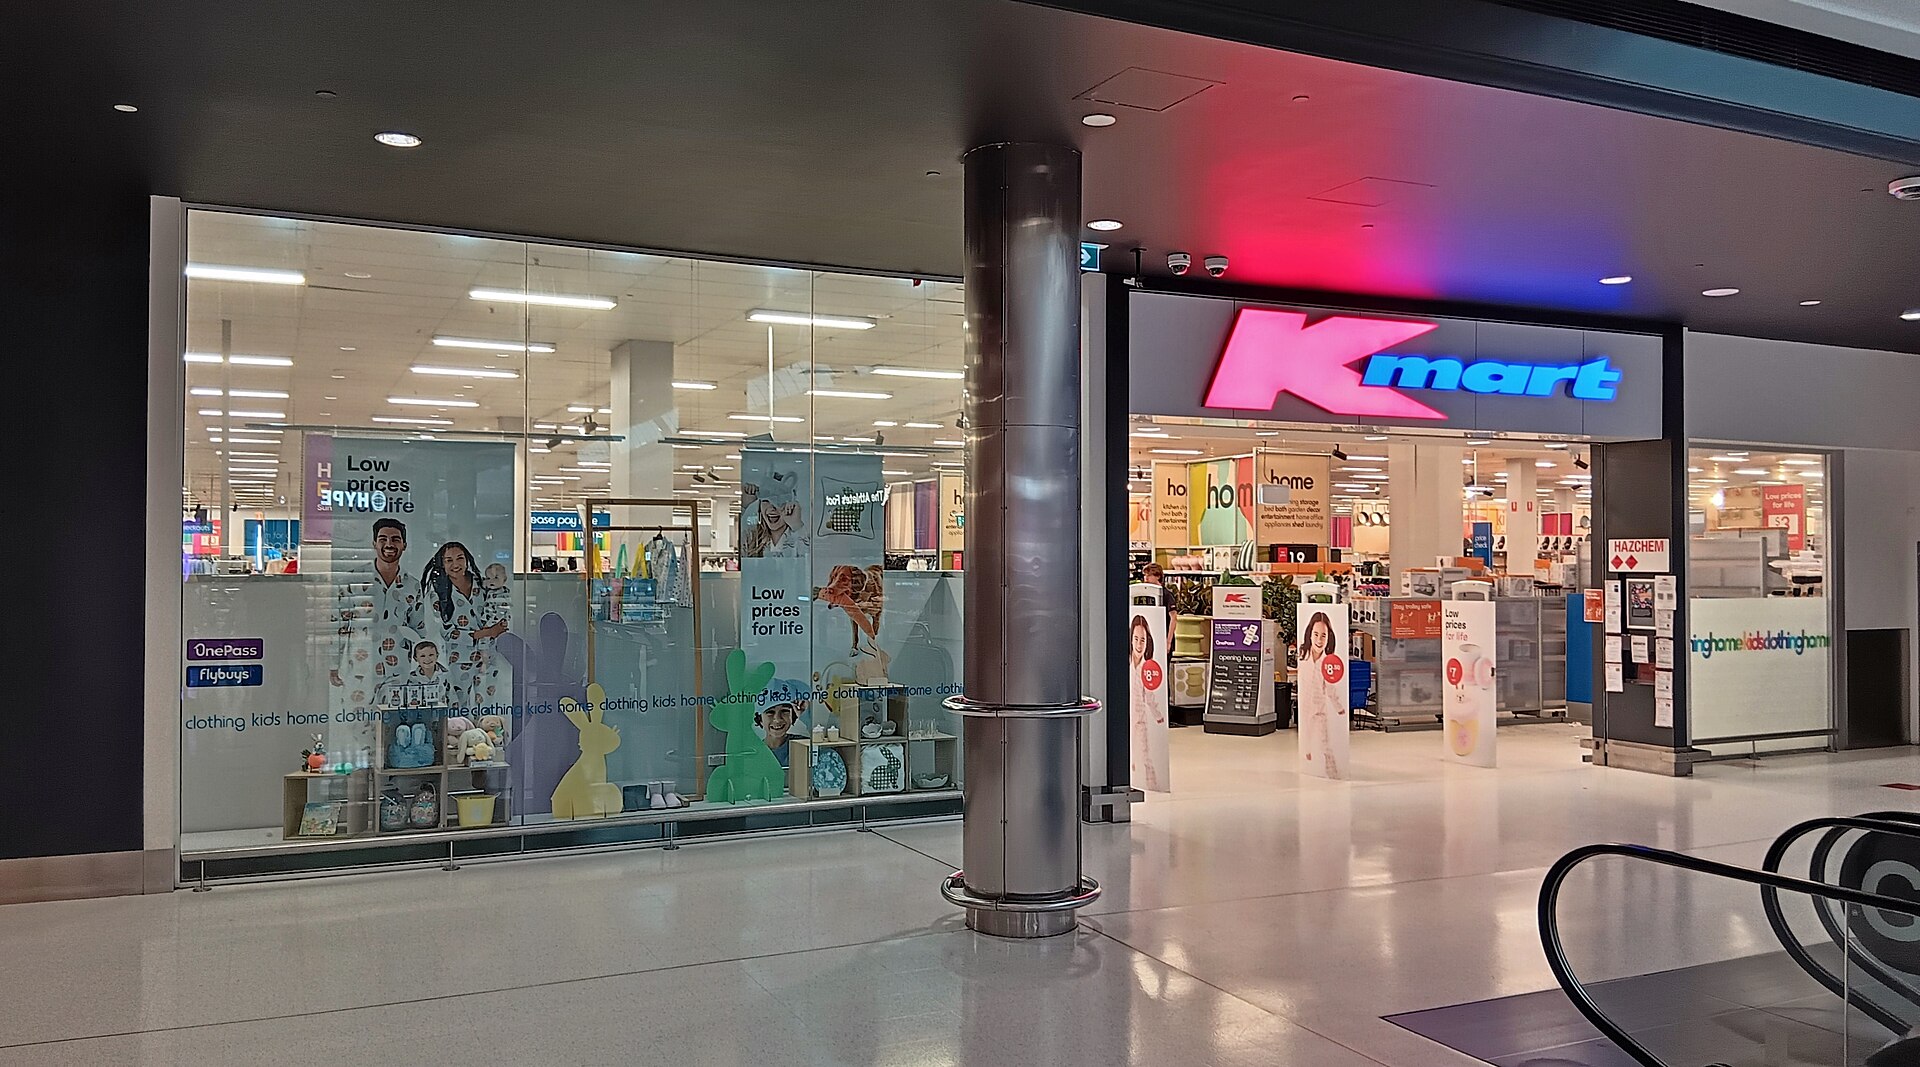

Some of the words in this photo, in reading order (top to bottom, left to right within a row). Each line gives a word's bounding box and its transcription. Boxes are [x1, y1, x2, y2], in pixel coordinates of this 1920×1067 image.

[1202, 307, 1620, 420] Kmart
[347, 455, 390, 472] Low
[347, 475, 410, 493] prices
[1167, 478, 1187, 496] ho
[1271, 469, 1314, 490] home
[1780, 492, 1802, 501] prices
[557, 516, 577, 528] pay
[1614, 540, 1664, 552] HAZCHEM
[752, 585, 785, 600] Low
[752, 602, 800, 621] prices
[1445, 608, 1459, 618] Low
[751, 621, 775, 636] for
[780, 621, 804, 635] life
[1445, 620, 1467, 630] prices
[1446, 631, 1455, 640] for
[1456, 631, 1468, 641] life
[193, 643, 257, 657] OnePass
[1242, 654, 1257, 662] hours
[200, 668, 249, 684] flybuys
[185, 715, 246, 731] clothing
[251, 712, 281, 727] kids
[287, 711, 329, 725] home
[471, 703, 522, 717] clothing
[527, 701, 552, 714] kids
[558, 700, 594, 713] home
[600, 698, 648, 712] clothing
[653, 695, 676, 708] kids
[681, 694, 714, 706] home
[721, 691, 766, 706] clothing
[796, 688, 828, 700] home
